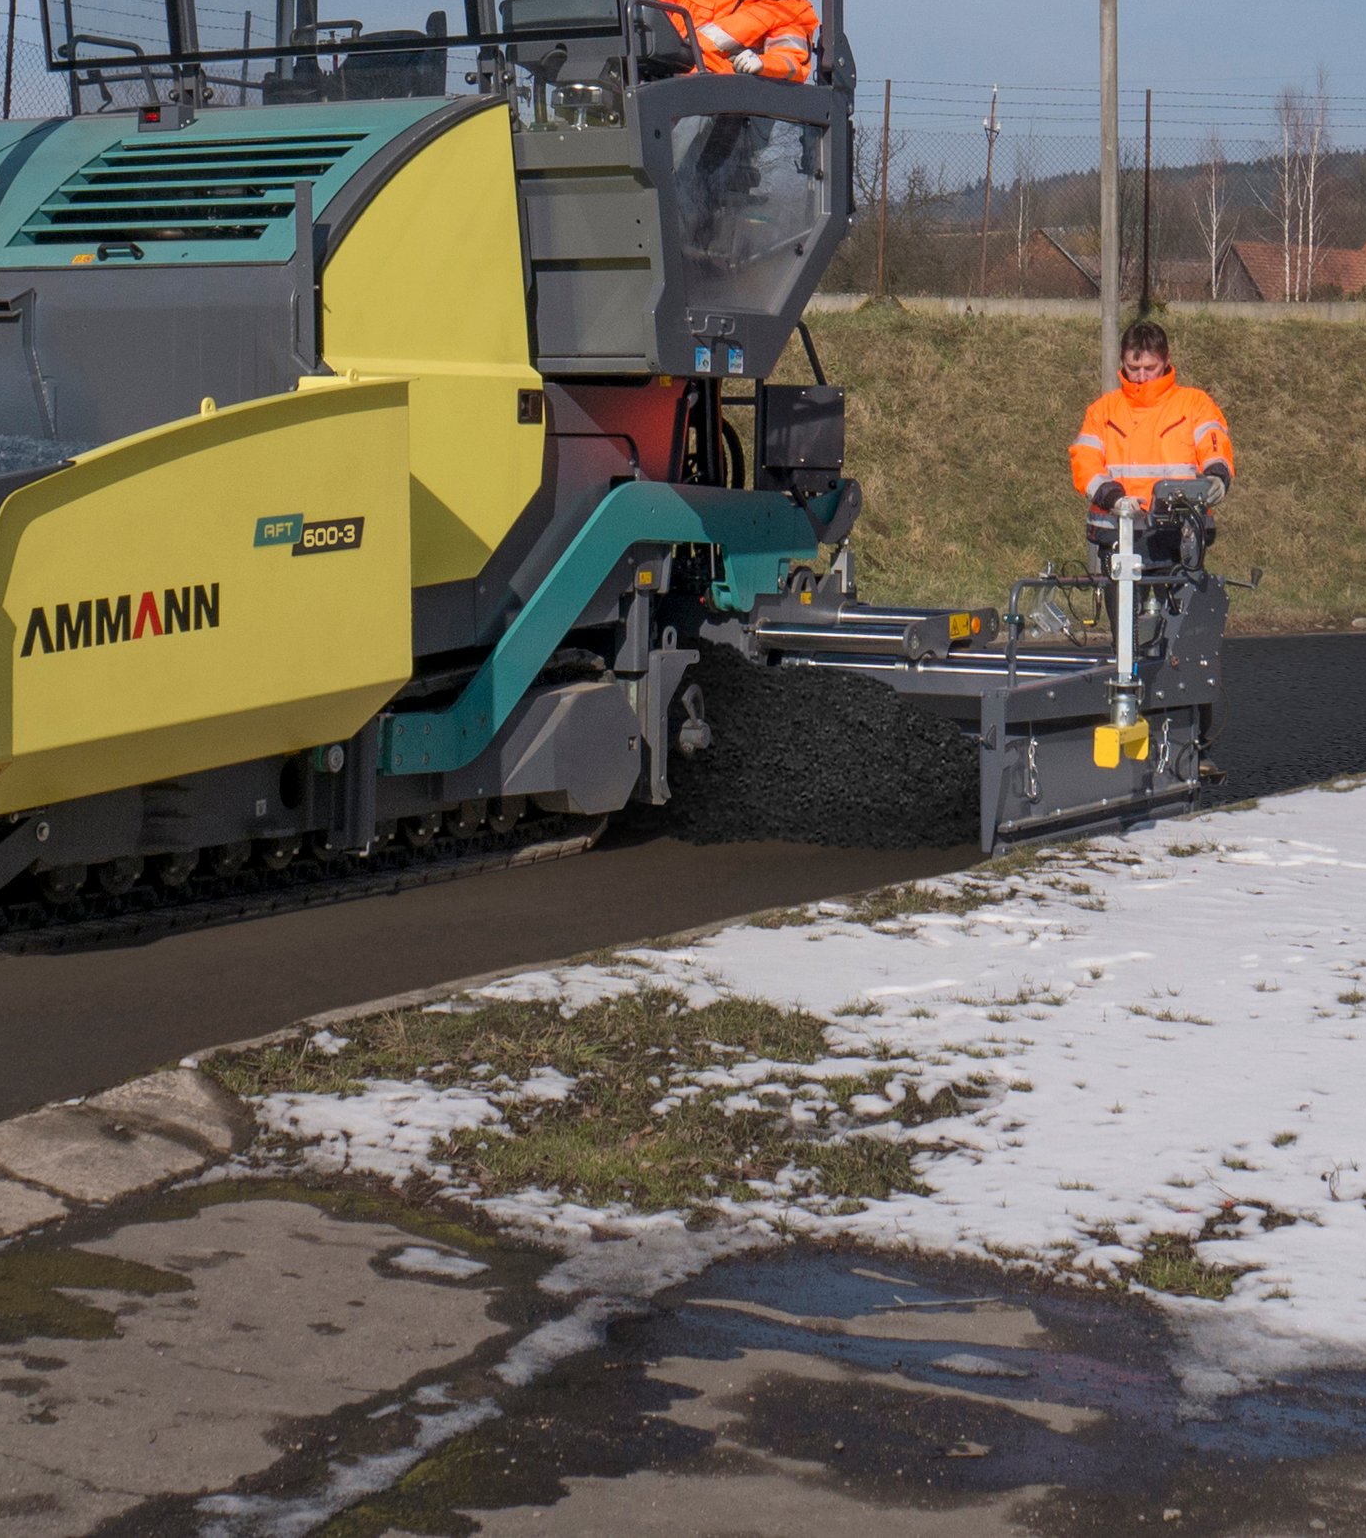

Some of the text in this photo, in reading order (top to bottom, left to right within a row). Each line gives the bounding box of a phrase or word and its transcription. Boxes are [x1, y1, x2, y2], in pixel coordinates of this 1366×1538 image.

[264, 522, 356, 548] AFT 600-3
[19, 582, 220, 659] AMMANN
